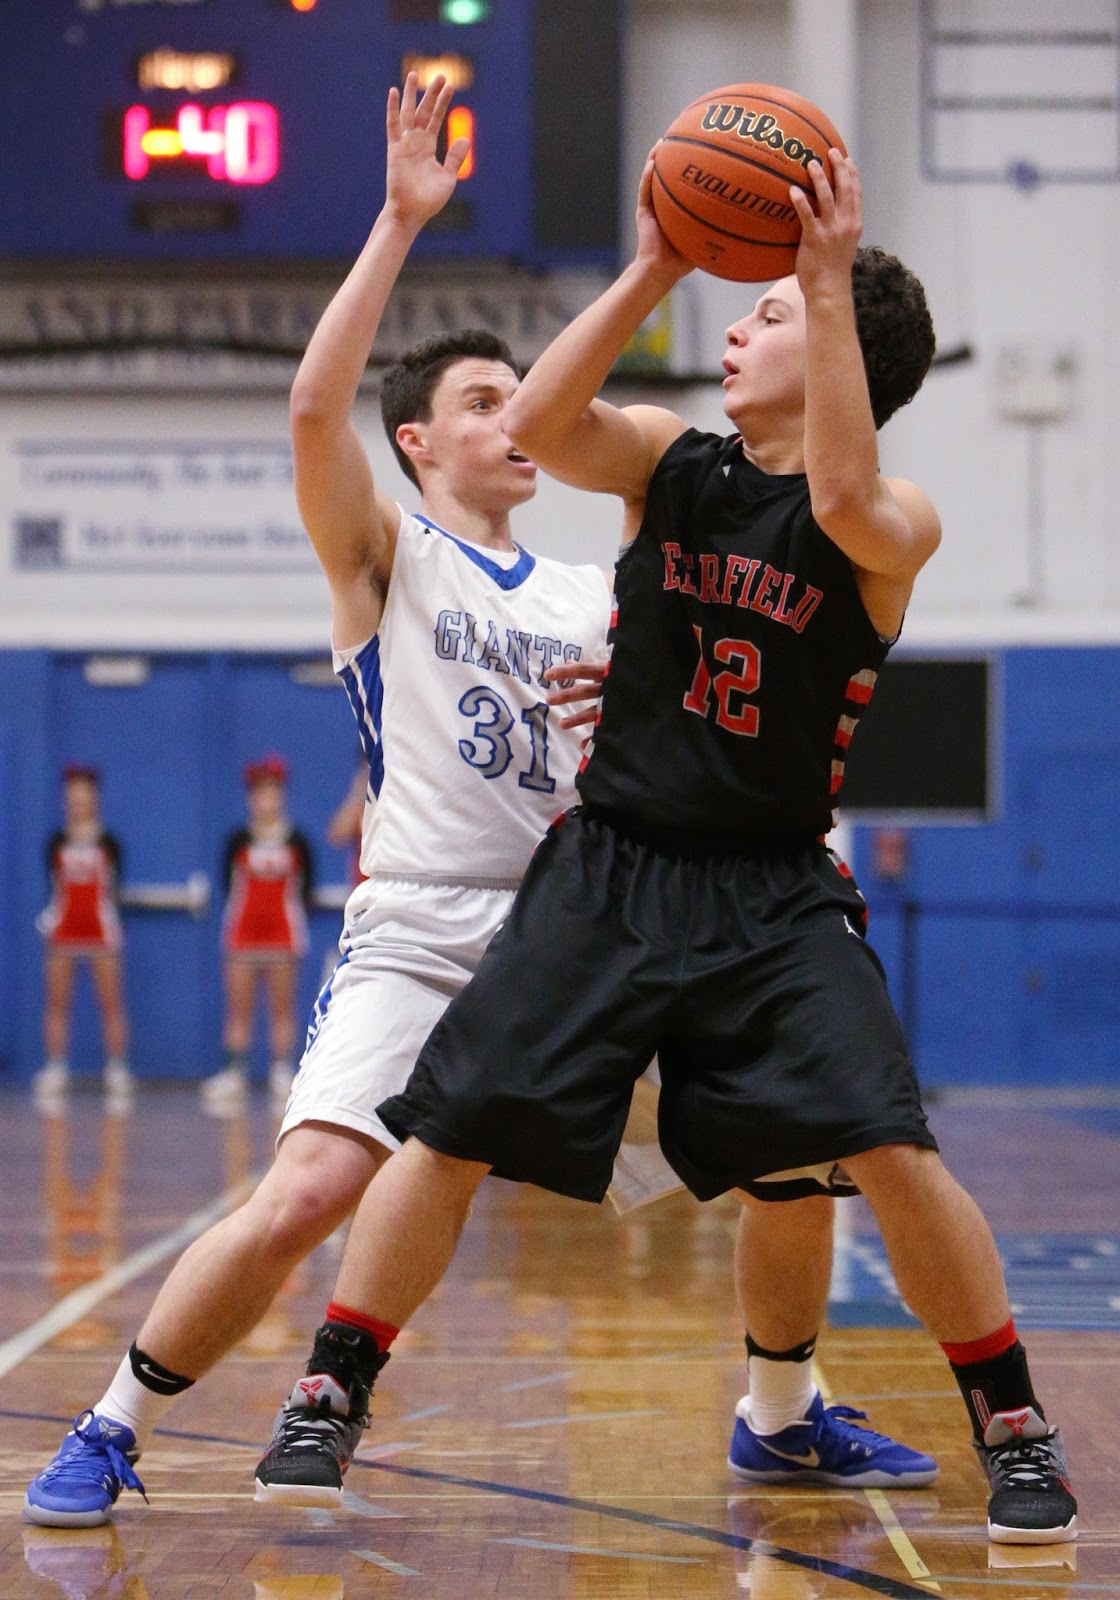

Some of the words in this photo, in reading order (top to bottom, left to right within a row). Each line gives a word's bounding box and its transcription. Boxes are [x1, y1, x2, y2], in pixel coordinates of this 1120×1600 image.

[701, 104, 823, 170] Wilson
[681, 163, 798, 223] EVOLUTION
[660, 541, 824, 634] EERFIELD
[434, 609, 582, 689] GIANTS
[682, 623, 762, 738] 12
[458, 685, 556, 794] 31
